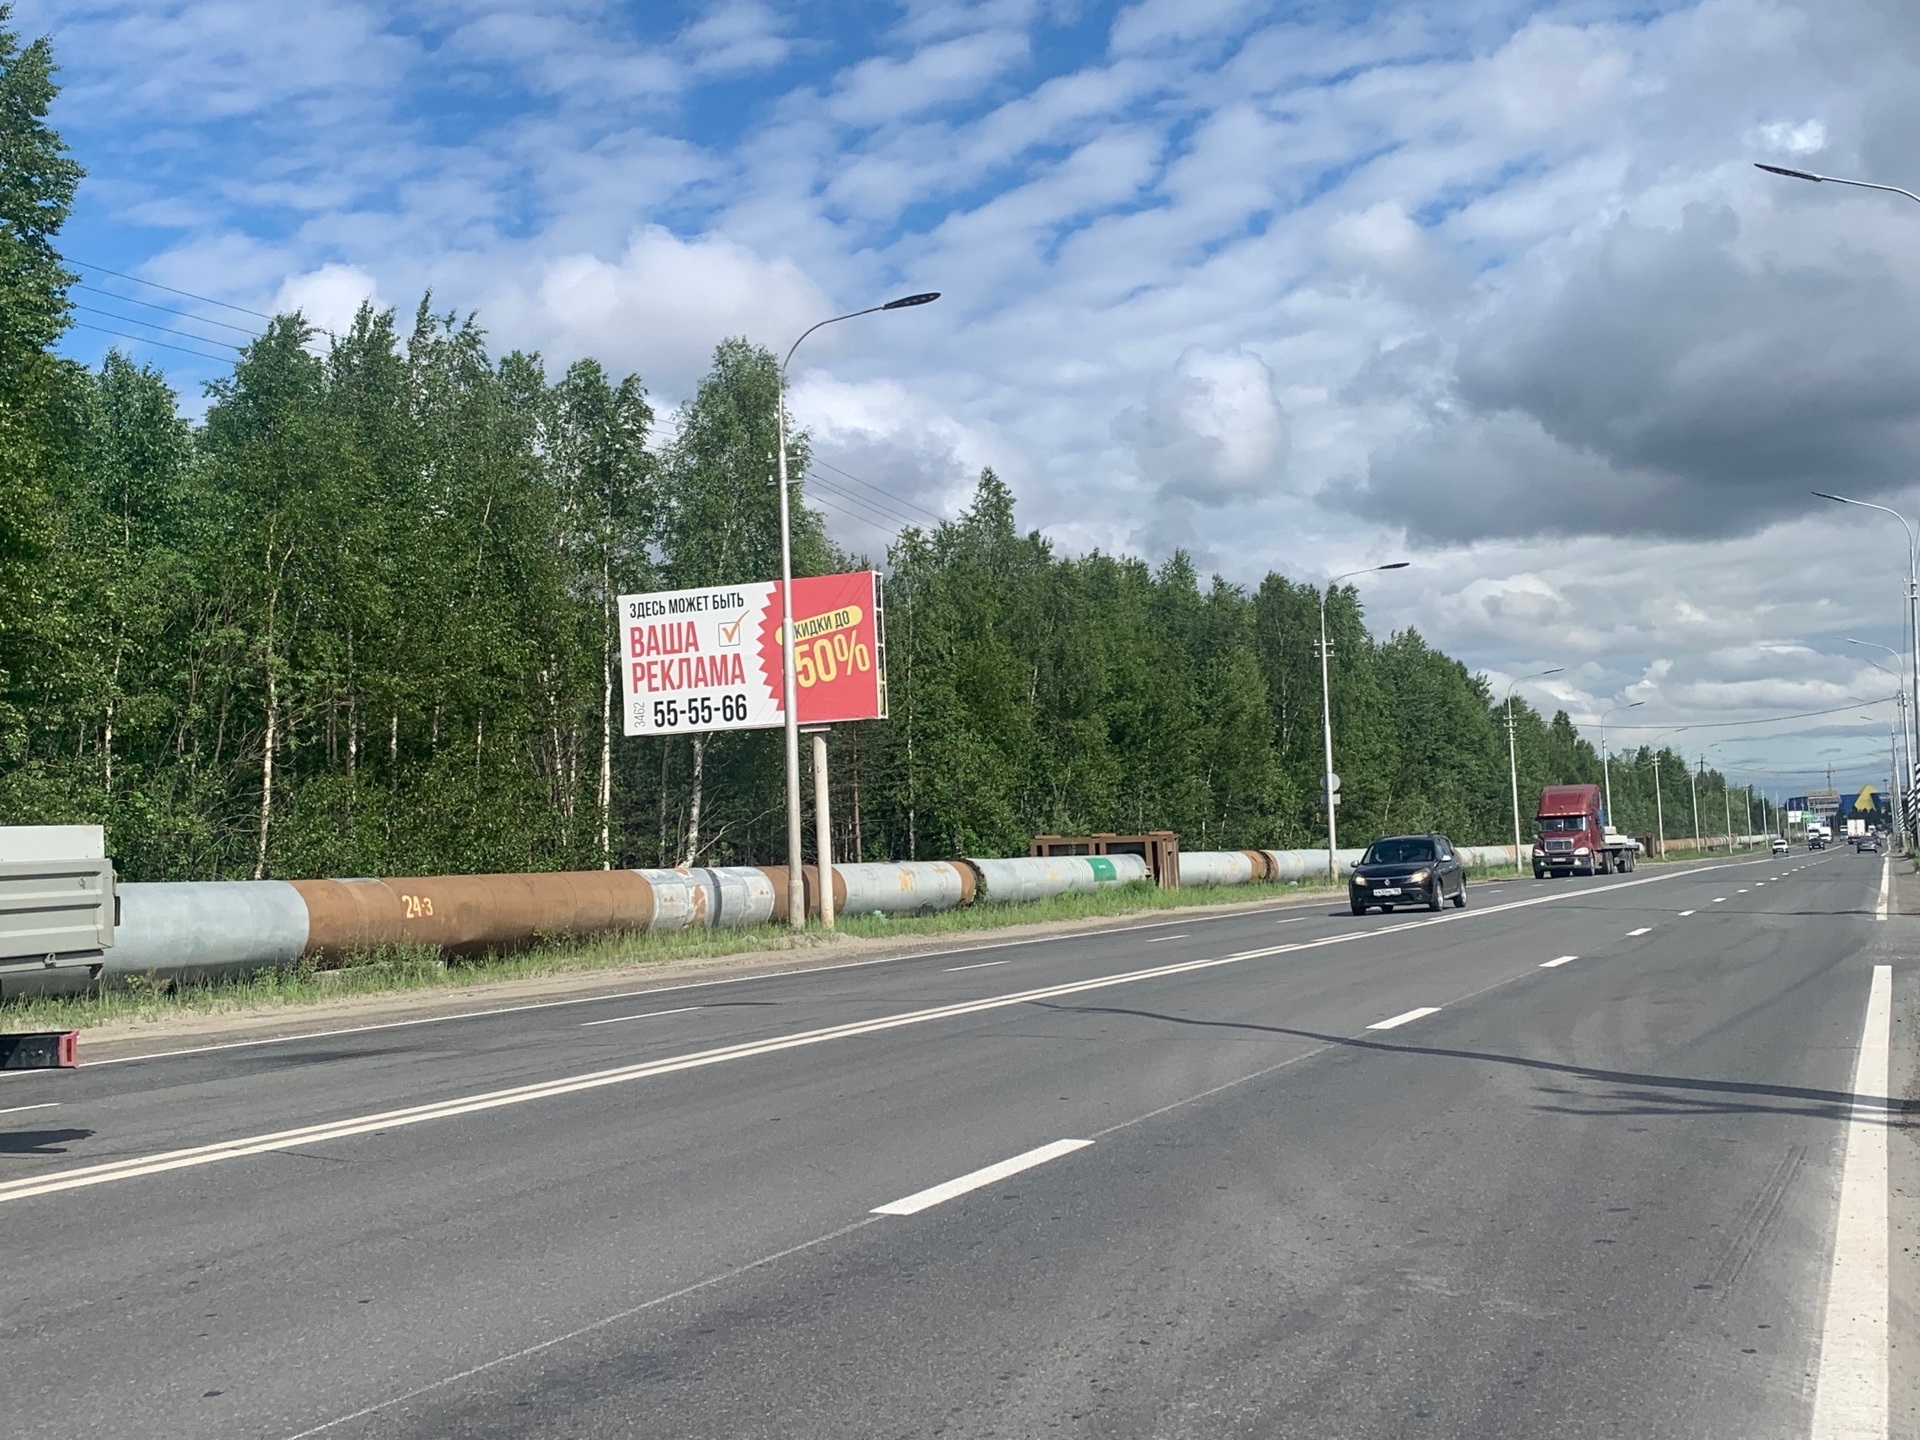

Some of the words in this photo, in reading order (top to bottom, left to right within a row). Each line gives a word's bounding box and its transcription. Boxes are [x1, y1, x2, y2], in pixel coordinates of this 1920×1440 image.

[629, 600, 666, 619] ЗДЕСЬ
[668, 595, 709, 614] МОЖЕТ
[712, 592, 744, 610] БЫТЬ
[630, 621, 699, 658] ВАША
[793, 615, 833, 640] КИДКИ
[834, 610, 850, 629] ДО
[632, 653, 746, 694] РЕКЛАМА
[794, 629, 871, 688] 50%
[633, 702, 646, 728] 3462
[653, 693, 748, 728] 55-55-66
